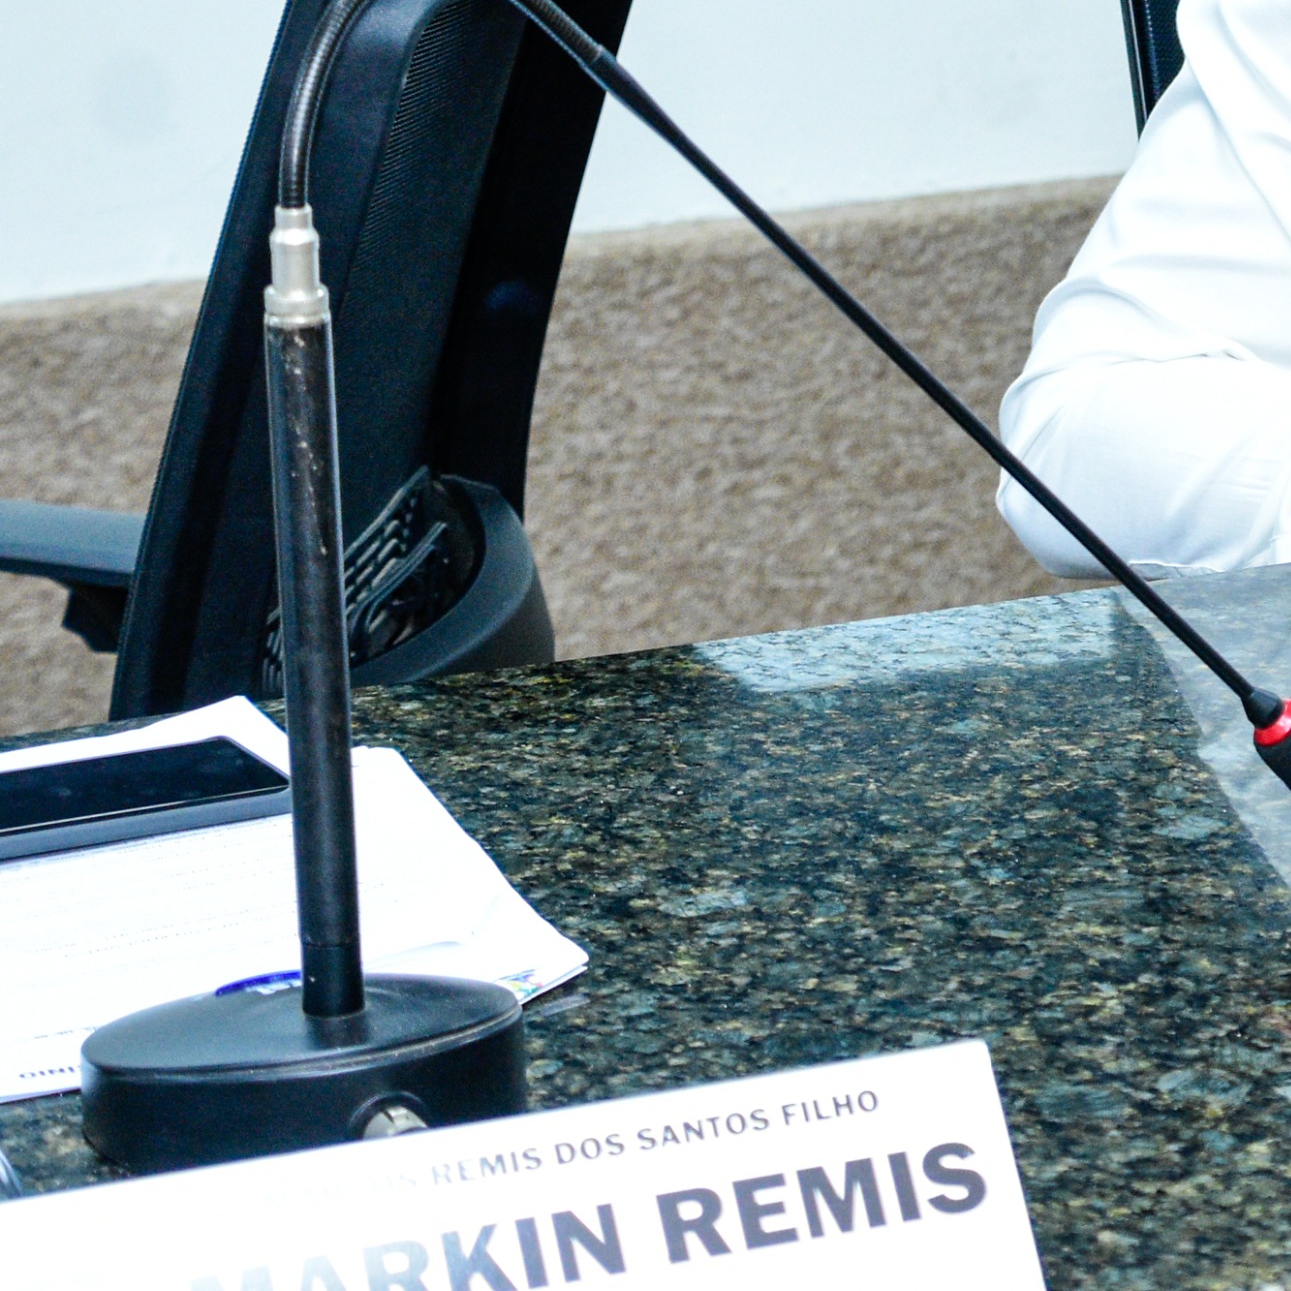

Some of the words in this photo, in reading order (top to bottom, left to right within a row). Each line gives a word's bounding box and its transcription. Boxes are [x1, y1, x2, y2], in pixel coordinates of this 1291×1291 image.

[431, 1149, 543, 1187] REMIS
[554, 1133, 626, 1166] DOS
[636, 1108, 771, 1152] SANTOS
[781, 1090, 880, 1127] FILHO
[655, 1142, 988, 1264] REMIS
